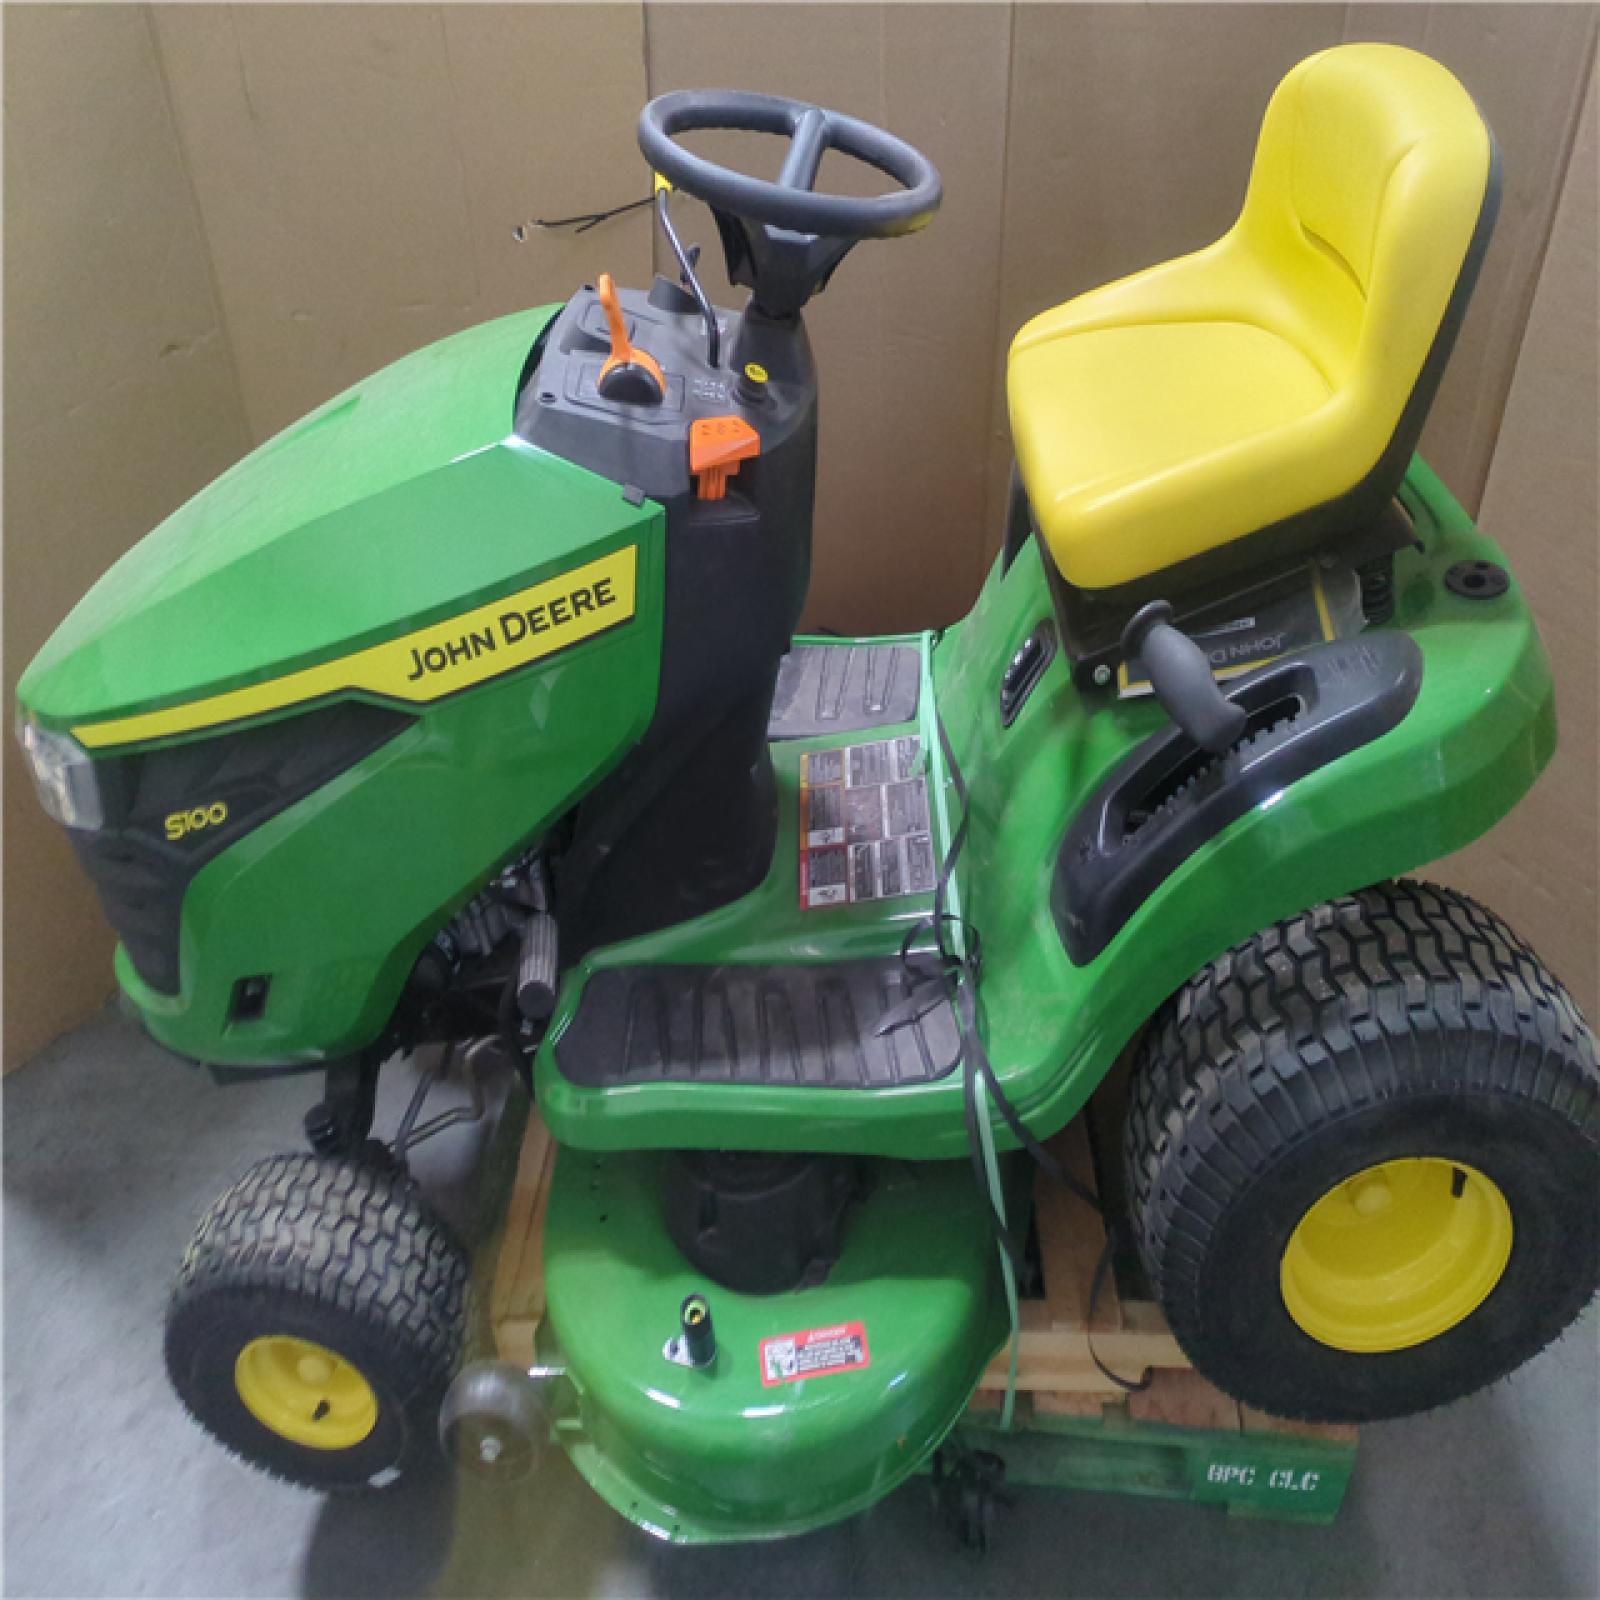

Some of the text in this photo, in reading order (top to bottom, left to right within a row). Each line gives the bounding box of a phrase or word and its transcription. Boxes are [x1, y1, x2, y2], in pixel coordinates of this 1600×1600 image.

[407, 577, 616, 681] JOHN DEERE
[165, 801, 228, 840] S100
